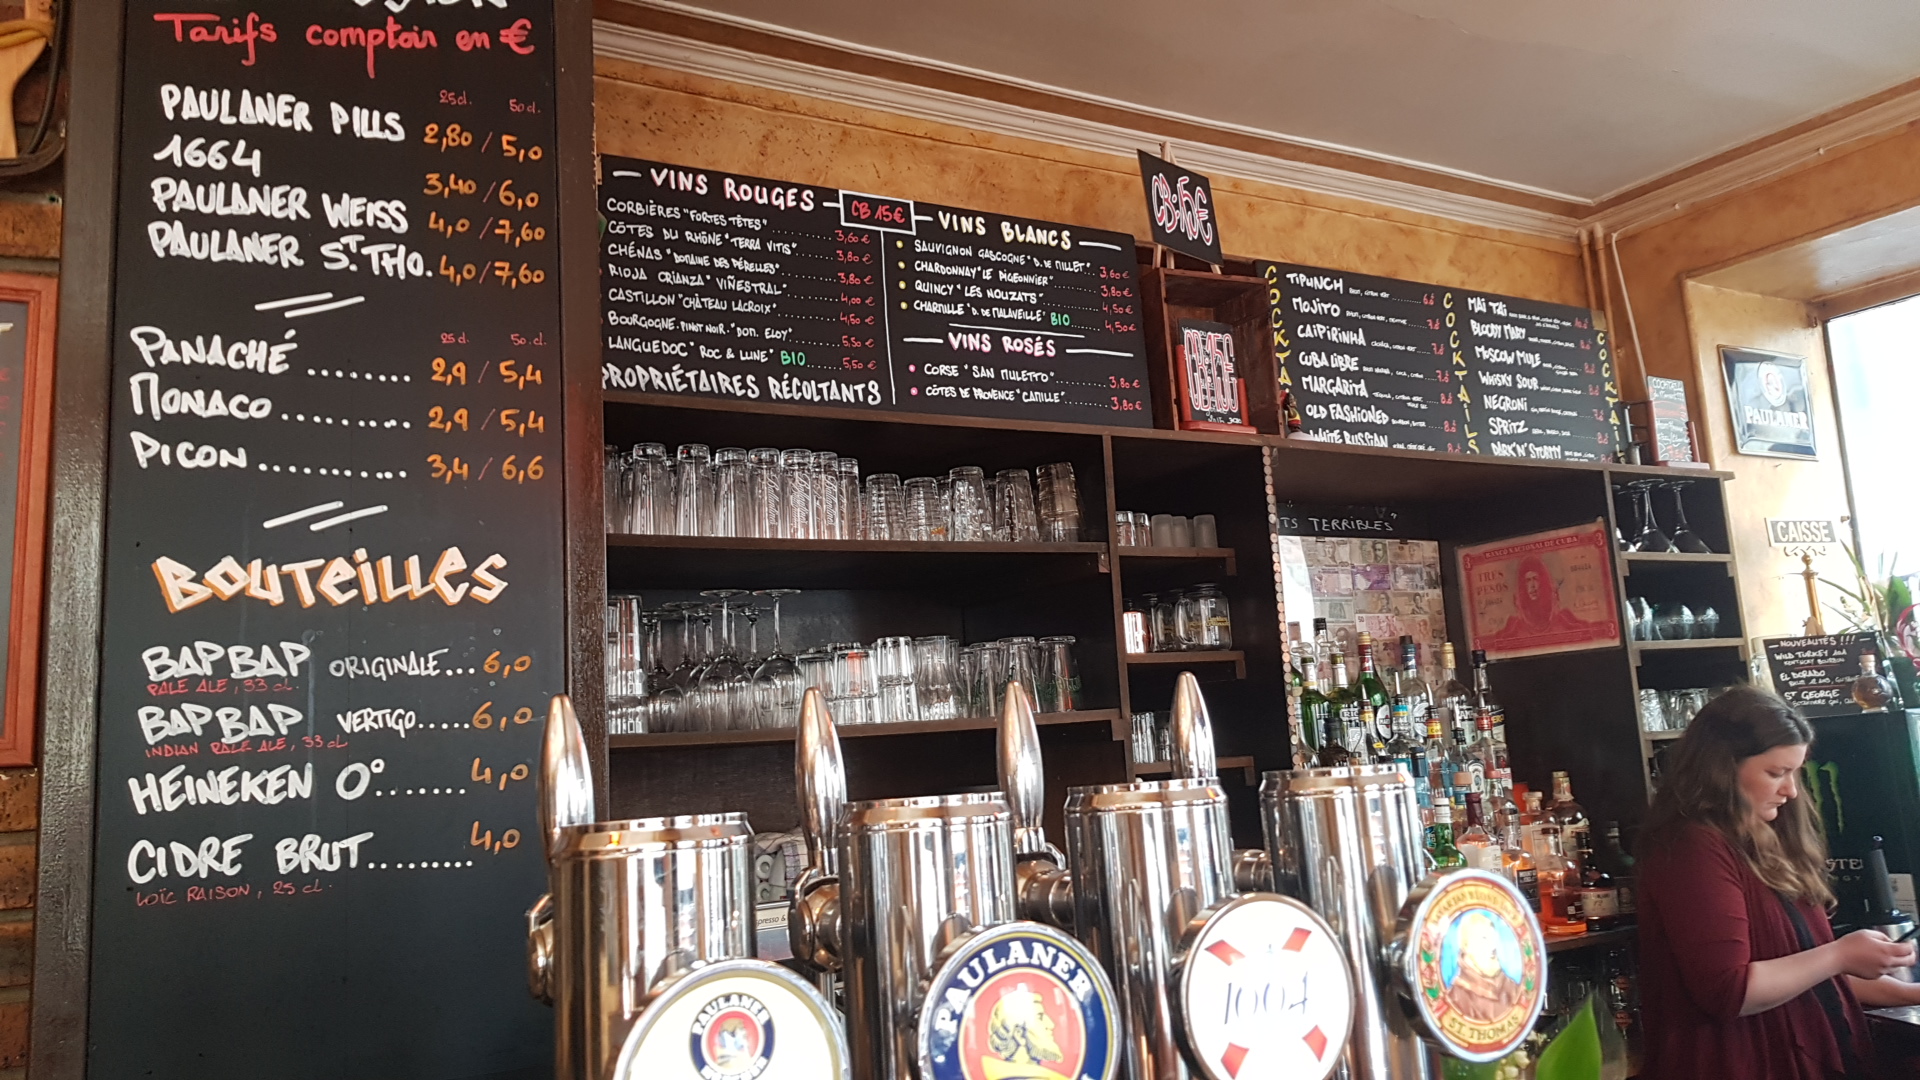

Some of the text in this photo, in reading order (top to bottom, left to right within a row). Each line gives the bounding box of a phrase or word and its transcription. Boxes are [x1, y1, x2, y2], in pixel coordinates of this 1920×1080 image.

[154, 12, 535, 78] Tarifs comptoir en €
[160, 84, 542, 162] PAULANER PILLS 2,80 5,0
[153, 135, 539, 211] 1664 3,40 6,0
[650, 168, 814, 212] VINS ROUGES
[151, 176, 546, 248] PAULANER WEISS 4,0 7,60
[607, 198, 681, 219] CORBIÈRES
[851, 201, 905, 224] CB 15€
[662, 228, 678, 240] DU
[938, 211, 1071, 250] VINS BLANCS
[147, 220, 304, 269] PAULANER
[439, 256, 476, 286] 4,0
[495, 261, 545, 289] 7,60
[608, 241, 663, 260] CHÉNAS
[713, 257, 729, 268] DES
[914, 239, 972, 257] SAUVIGNON
[978, 249, 1025, 265] GASCOGNE
[608, 263, 647, 280] RIOJA
[658, 271, 704, 286] CRIANZA
[914, 261, 976, 280] CHARDONNAY
[609, 288, 675, 306] CASTILLON
[914, 280, 954, 295] QUINCY
[914, 300, 964, 315] CHARMILLE
[1050, 312, 1070, 326] BIO
[680, 321, 703, 332] PINOT
[1470, 319, 1502, 338] BLOODY
[1503, 323, 1526, 341] MARY
[948, 332, 1056, 357] VINS ROSÉS
[1475, 345, 1541, 368] MOSCOW MULE
[130, 326, 297, 374] PANACHÉ
[499, 359, 542, 389] 5,4
[780, 350, 805, 366] BIO
[1299, 351, 1329, 369] CUBA
[924, 363, 959, 378] CORSE
[1516, 373, 1539, 391] SOUR
[602, 363, 881, 405] PROPRIÉTAIRES RÉCOLTANTS
[959, 387, 970, 398] DE
[973, 388, 1015, 401] PROVENCE
[130, 372, 272, 421] MONACO
[500, 408, 544, 437] 5,4
[1306, 404, 1327, 419] OLD
[1744, 406, 1809, 430] PAULANER
[130, 431, 545, 485] PICON 3,4 6,6
[1777, 521, 1832, 542] CAISSE
[142, 640, 531, 681] BAPBAP ORIGINALE 6,0
[1791, 669, 1825, 679] DORADO
[147, 677, 268, 696] PALE 33
[1801, 689, 1839, 700] GEORGE
[137, 701, 532, 745] BAPBAP VERTIGO 6,0
[145, 734, 325, 758] INDIAN PALE 33
[128, 757, 529, 814] HEINEKEN 4,0
[127, 820, 521, 884] CIDRE BRUT 4,0
[272, 881, 295, 895] 25
[936, 940, 1094, 1034] PAULANER
[691, 992, 771, 1035] PAULANER
[1469, 1015, 1520, 1041] THOMAS
